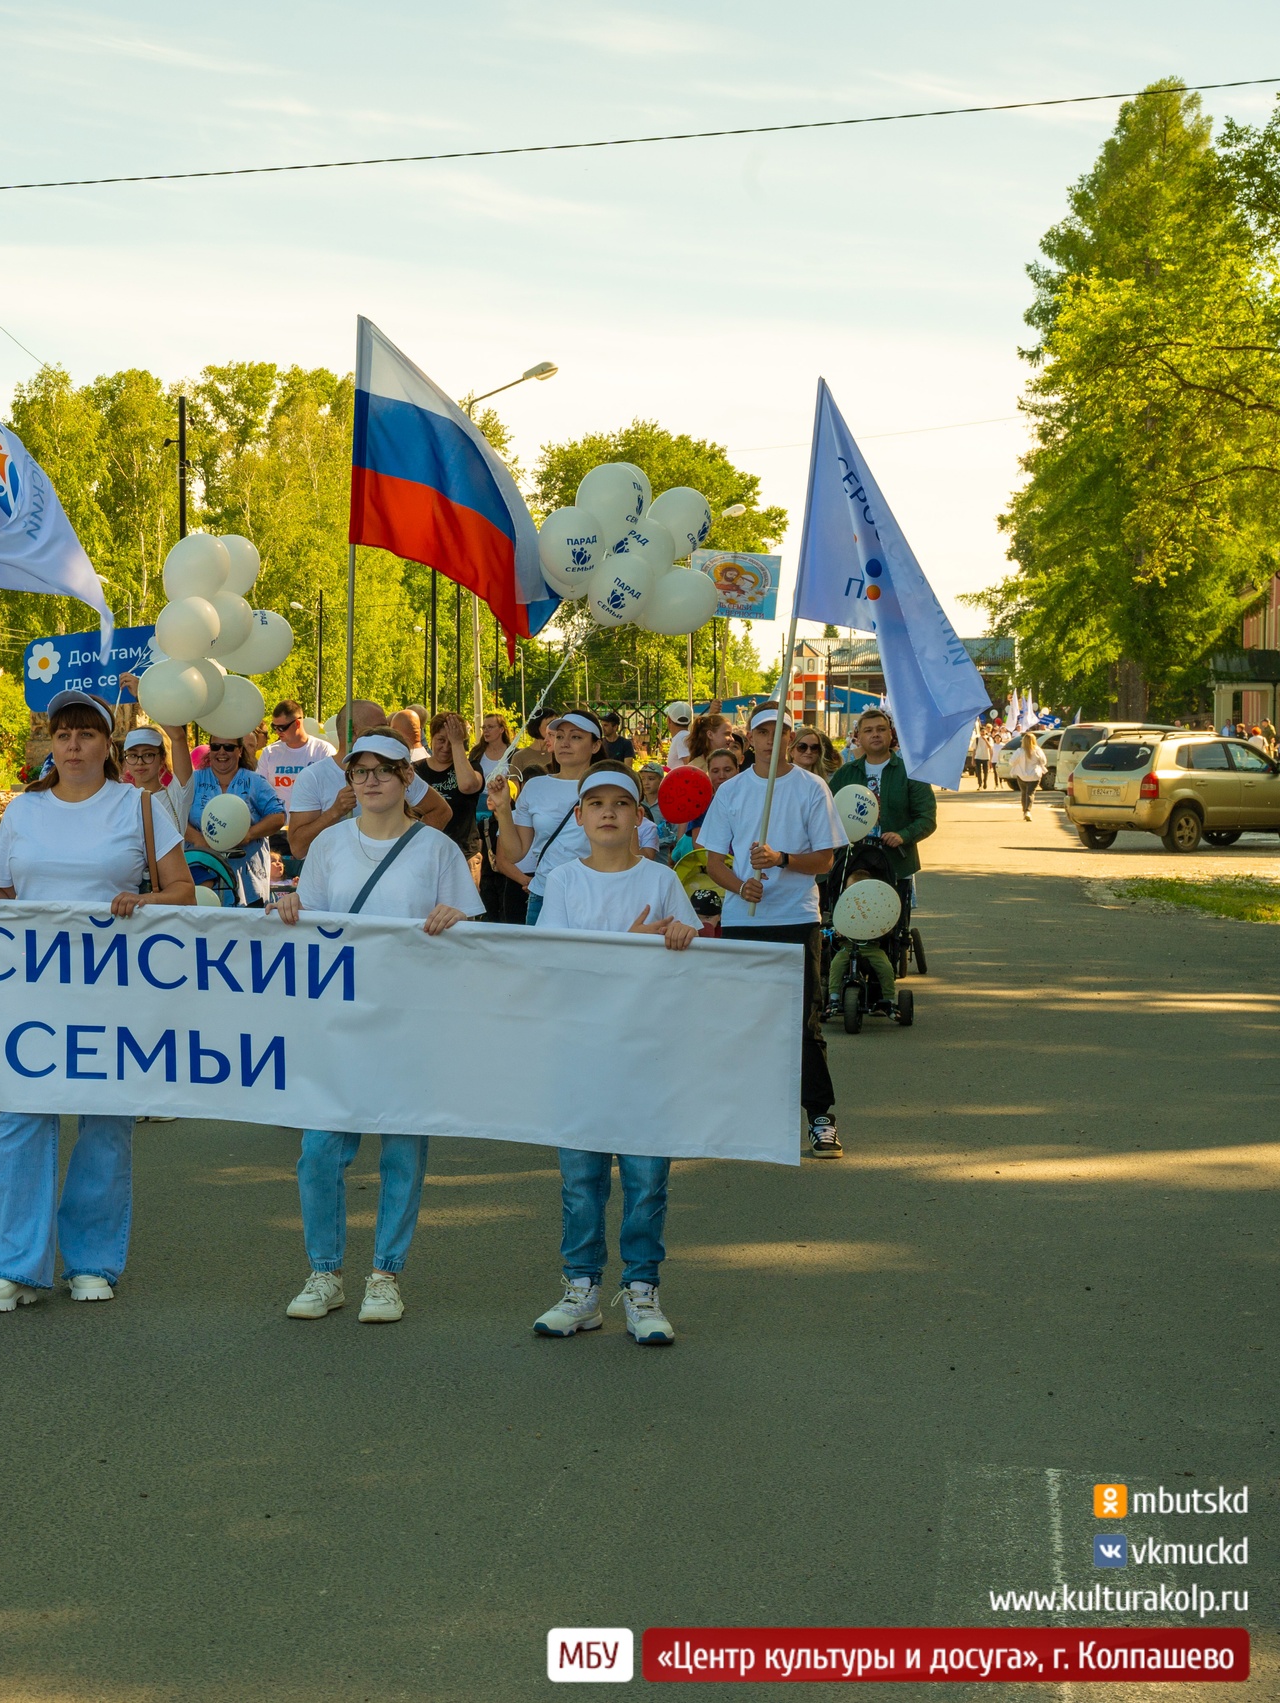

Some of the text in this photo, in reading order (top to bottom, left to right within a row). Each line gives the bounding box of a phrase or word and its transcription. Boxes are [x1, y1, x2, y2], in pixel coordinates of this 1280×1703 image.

[566, 535, 597, 546] ПАРАД
[565, 564, 595, 573] СЕМЬИ
[614, 577, 642, 600] ПАРАД
[597, 600, 623, 620] СЕМЬИ
[725, 609, 765, 619] ВЕРНОСТИ
[728, 603, 752, 611] СЕМЬИ
[67, 649, 101, 668] Дом
[64, 676, 93, 691] где
[275, 765, 305, 774] пап
[855, 793, 876, 808] ПАРАД
[208, 812, 228, 829] ПАРАД
[847, 813, 868, 826] СЕМЬИ
[5, 1020, 286, 1091] СЕМЬИ
